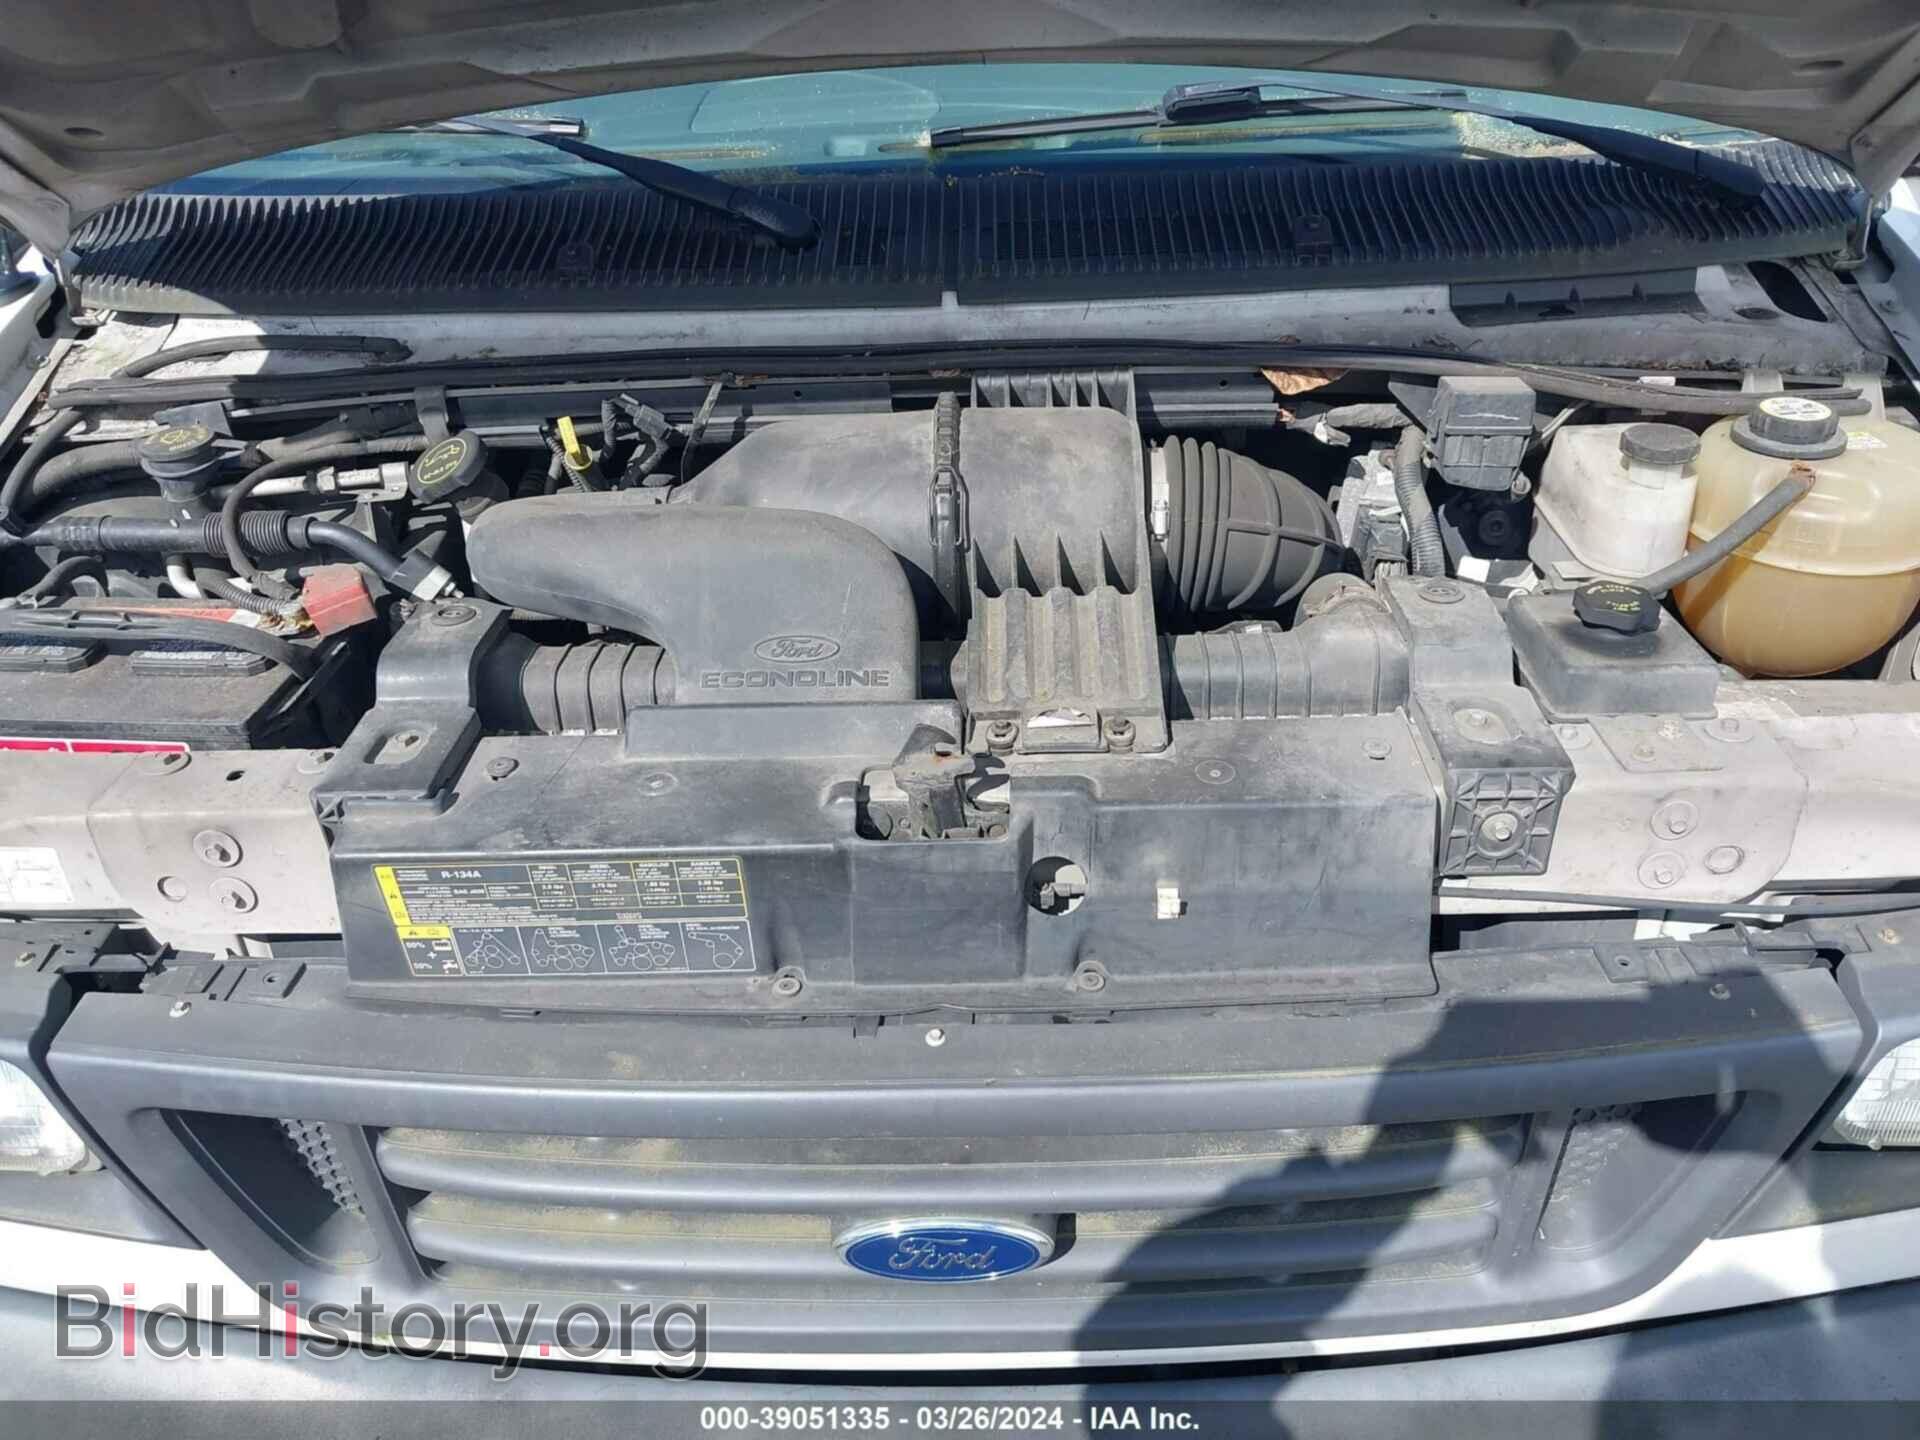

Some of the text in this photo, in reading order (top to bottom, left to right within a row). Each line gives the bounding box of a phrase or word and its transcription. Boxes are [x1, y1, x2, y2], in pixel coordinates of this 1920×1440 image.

[771, 638, 824, 658] Ford
[701, 670, 890, 689] ECONOLINE
[440, 870, 482, 879] R-134A
[888, 1237, 998, 1271] Ford
